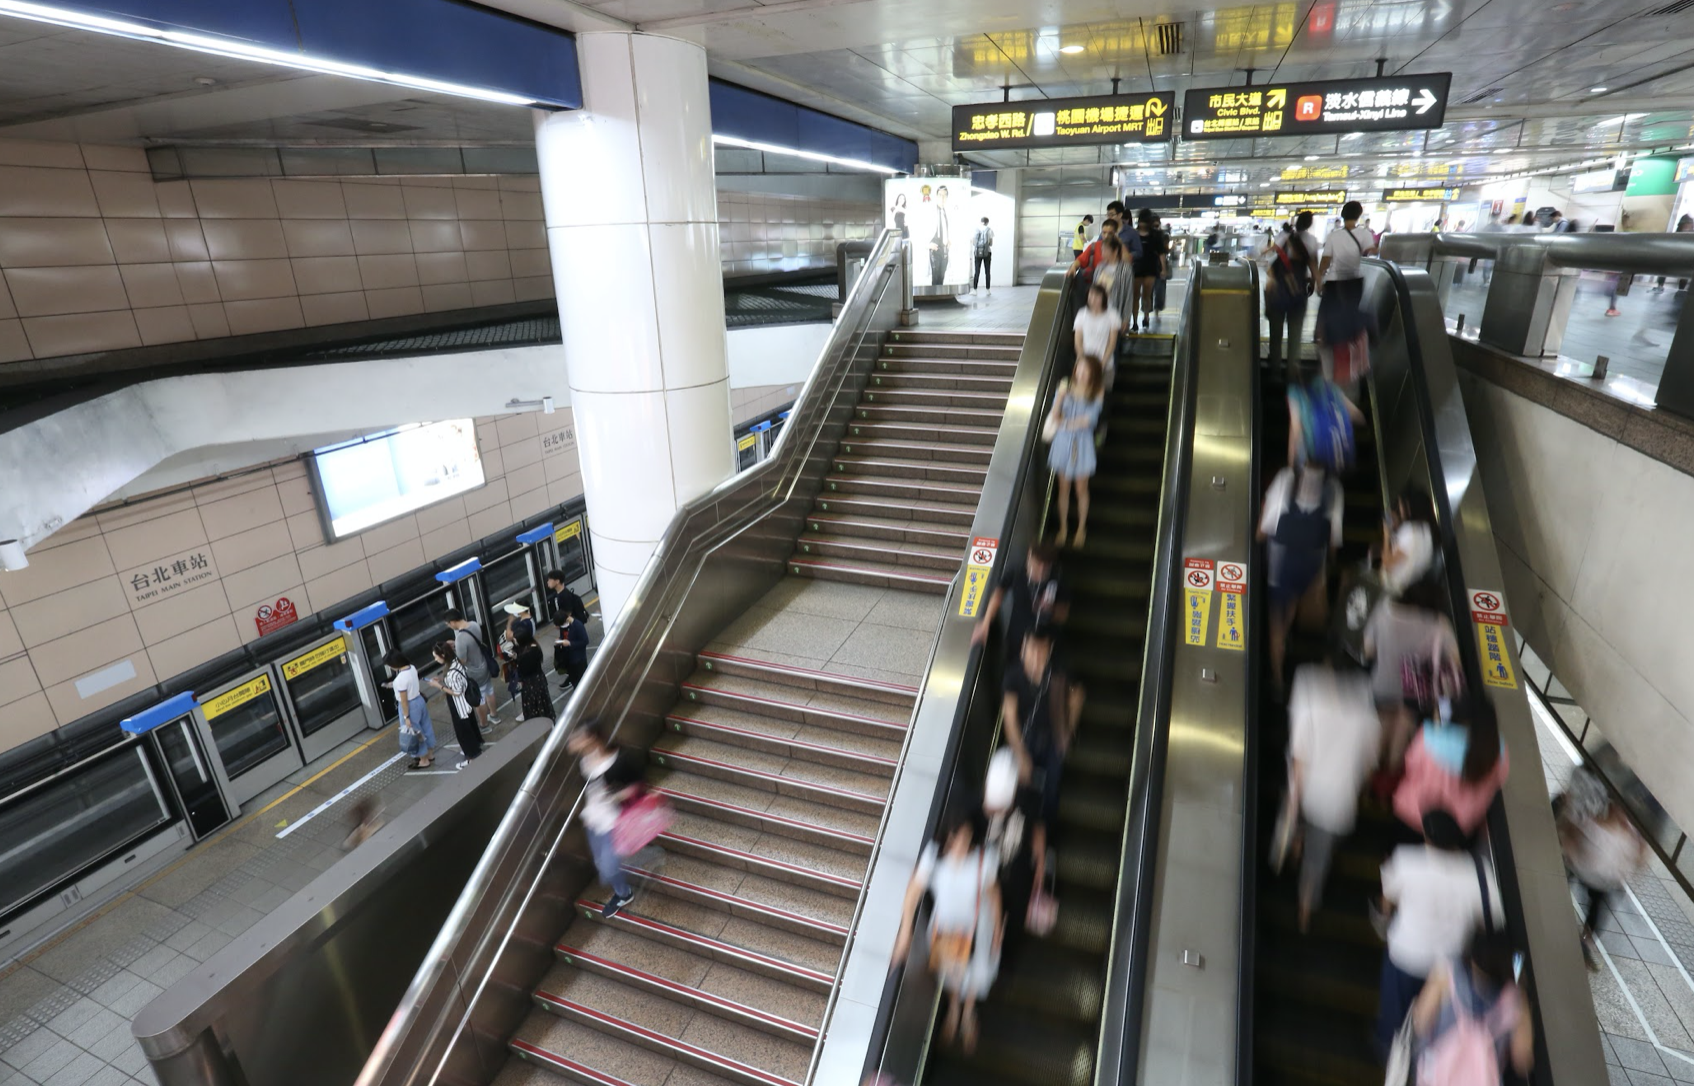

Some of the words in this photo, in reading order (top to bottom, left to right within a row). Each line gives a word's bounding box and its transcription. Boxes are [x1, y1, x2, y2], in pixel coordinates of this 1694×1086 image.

[1209, 92, 1262, 108] 市民大道
[1324, 89, 1410, 110] 淡水信義線
[1056, 105, 1144, 125] 桃園機場捷運
[1217, 108, 1238, 117] Civic
[1239, 106, 1261, 116] Blvd.
[1303, 103, 1314, 114] R
[1323, 109, 1384, 122] Tamsui-Xinyi
[1385, 108, 1407, 119] Line
[972, 113, 1026, 130] 忠孝西路
[1056, 125, 1091, 136] Taoyuan
[1092, 123, 1122, 135] Airport
[1123, 122, 1144, 132] MRT
[959, 132, 999, 141] Zhongxiao
[1000, 130, 1010, 138] W.
[1011, 129, 1025, 138] Rd.
[130, 553, 208, 592] 台北車站
[136, 590, 158, 602] TAIPEI
[161, 582, 181, 593] MAIN
[183, 570, 213, 585] STATION
